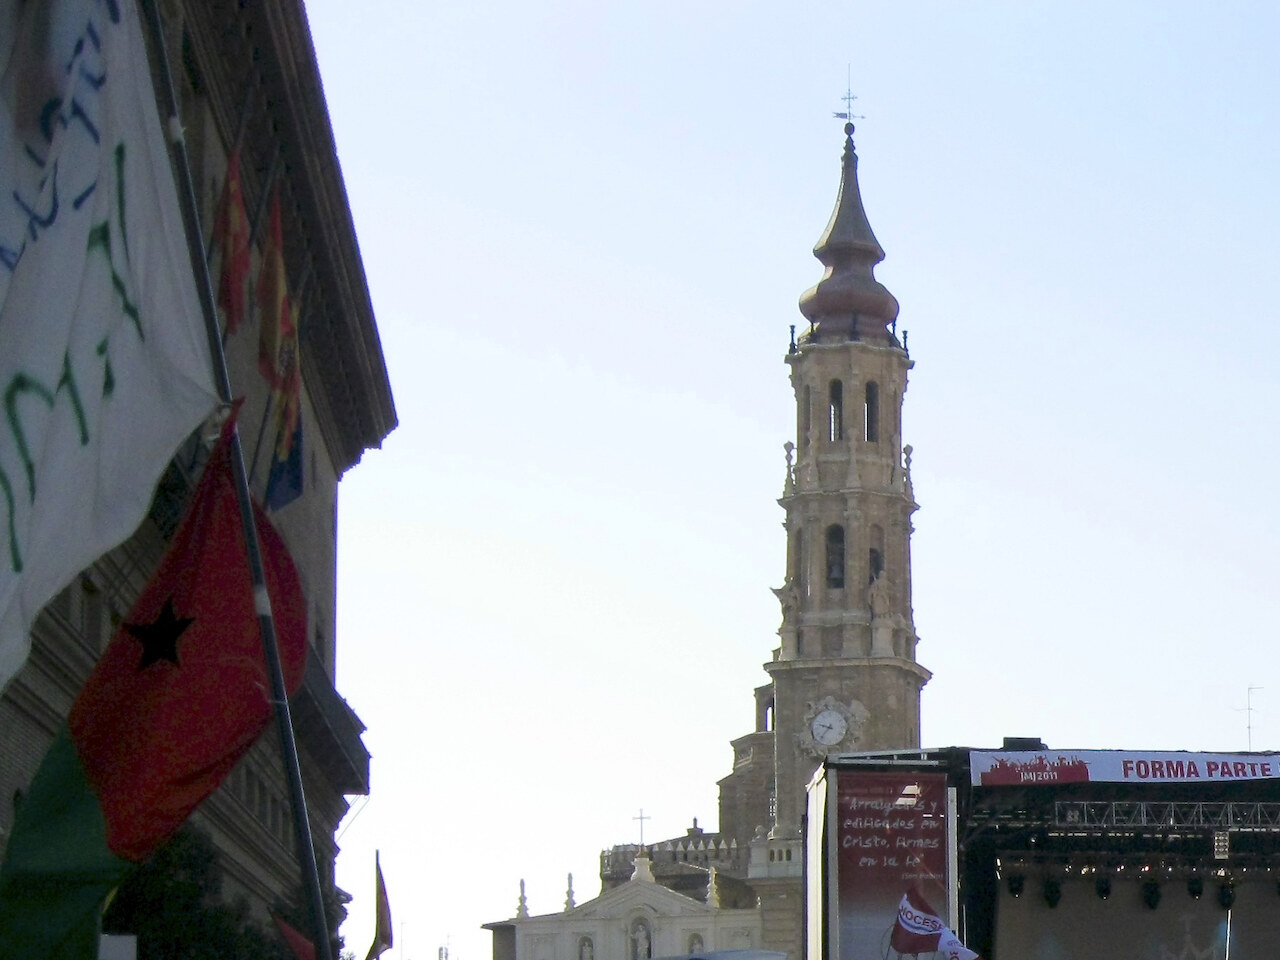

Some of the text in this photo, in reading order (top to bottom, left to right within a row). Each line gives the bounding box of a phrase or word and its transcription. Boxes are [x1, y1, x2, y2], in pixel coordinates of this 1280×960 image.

[1122, 759, 1200, 779] FORMA
[1206, 760, 1273, 778] PARTE
[1020, 771, 1058, 782] JMJ2011
[896, 835, 939, 848] firmes
[858, 856, 878, 867] en
[883, 855, 898, 867] la
